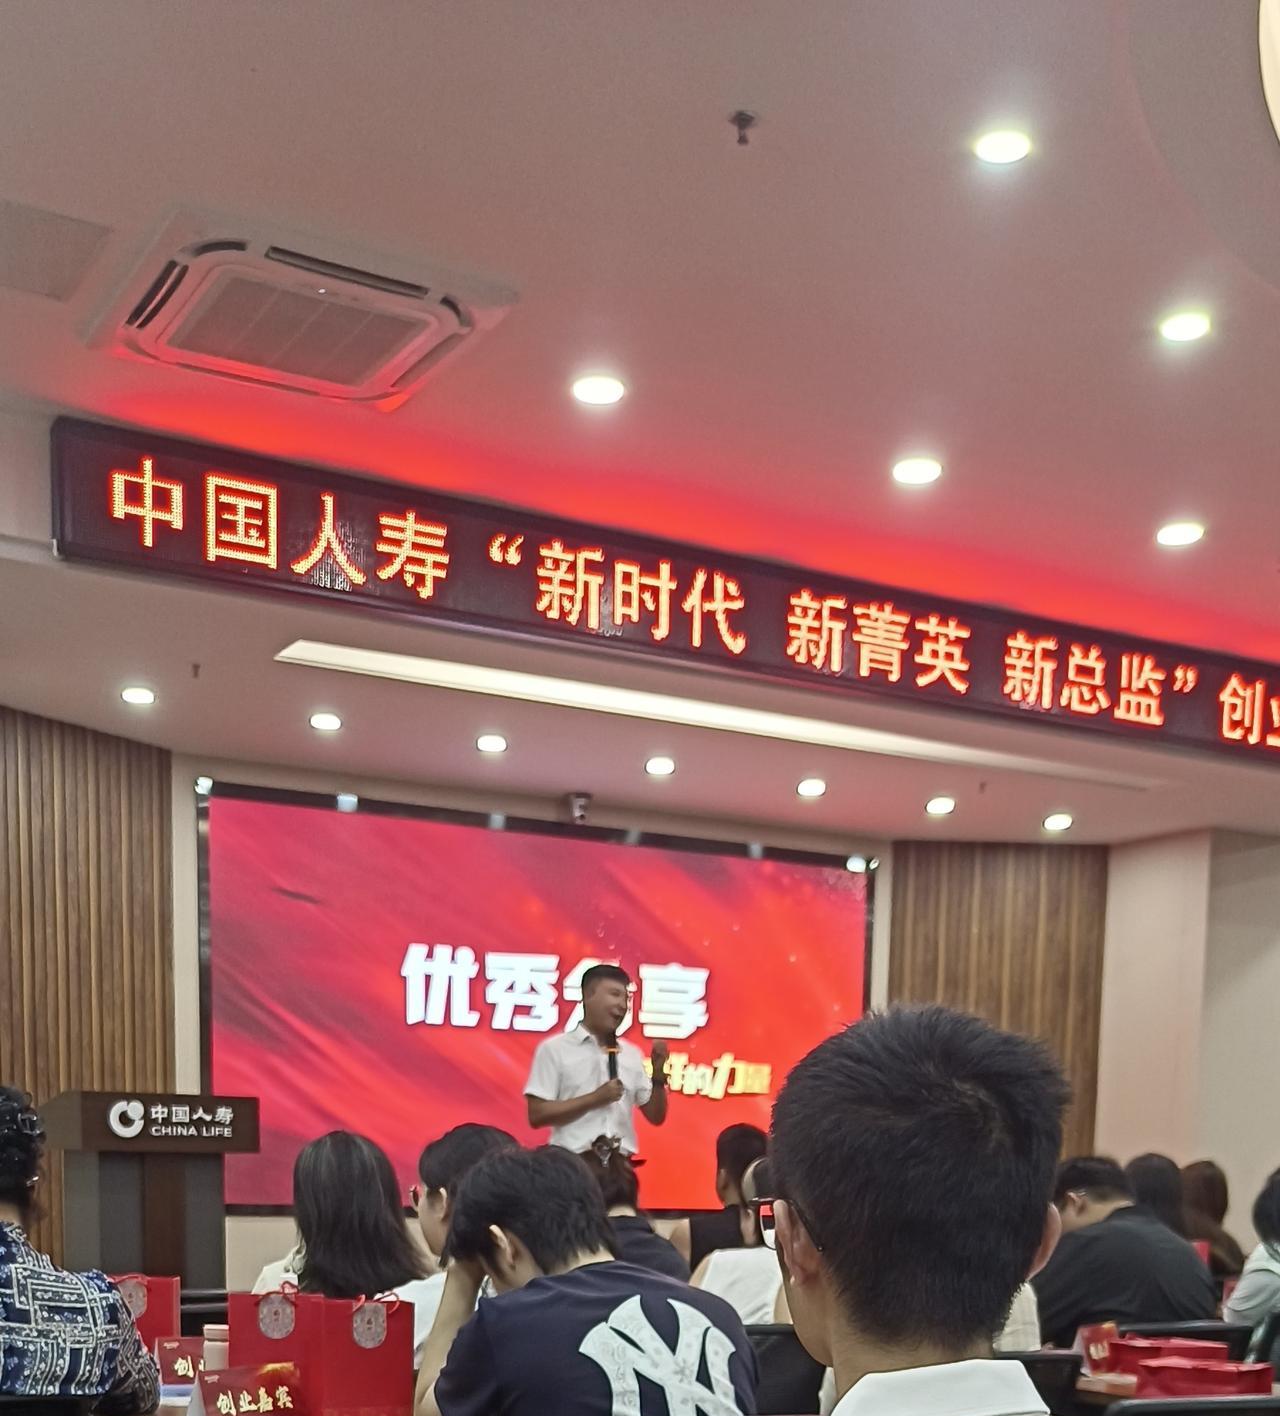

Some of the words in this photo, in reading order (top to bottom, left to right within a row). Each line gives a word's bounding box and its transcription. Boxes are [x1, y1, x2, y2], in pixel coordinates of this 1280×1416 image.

[786, 587, 972, 696] 新菁英
[1003, 629, 1280, 749] 新总监”创
[150, 1103, 234, 1125] 中国人寿
[151, 1125, 198, 1137] CHINA
[202, 1125, 232, 1138] LIFE
[216, 1385, 294, 1416] 创业嘉宾
